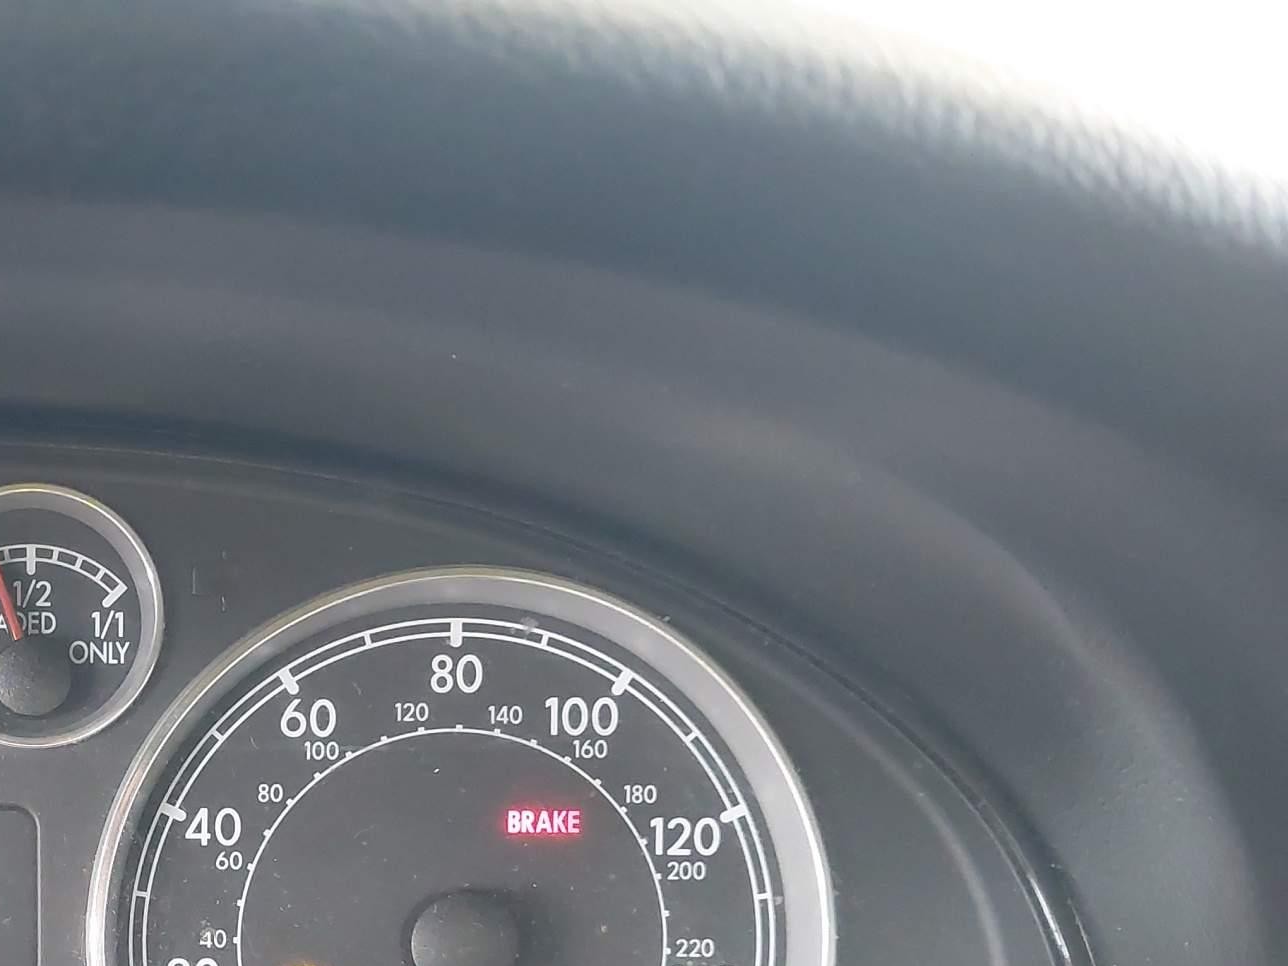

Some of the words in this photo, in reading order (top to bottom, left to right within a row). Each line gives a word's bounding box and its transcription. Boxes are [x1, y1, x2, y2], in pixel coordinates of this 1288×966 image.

[13, 579, 52, 608] 1/2
[91, 609, 124, 639] 1/1
[69, 640, 130, 664] ONLY
[430, 654, 483, 694] 80
[280, 698, 337, 738] 60
[394, 702, 429, 722] 120
[488, 705, 523, 725] 140
[545, 696, 619, 737] 100
[304, 740, 340, 761] 100
[572, 739, 608, 759] 160
[257, 783, 284, 803] 80
[623, 784, 657, 804] 180
[185, 809, 242, 846] 40
[506, 809, 581, 834] BRAKE
[649, 817, 721, 857] 120
[215, 851, 243, 870] 60
[667, 861, 706, 881] 200
[199, 929, 227, 949] 40
[675, 938, 715, 958] 220
